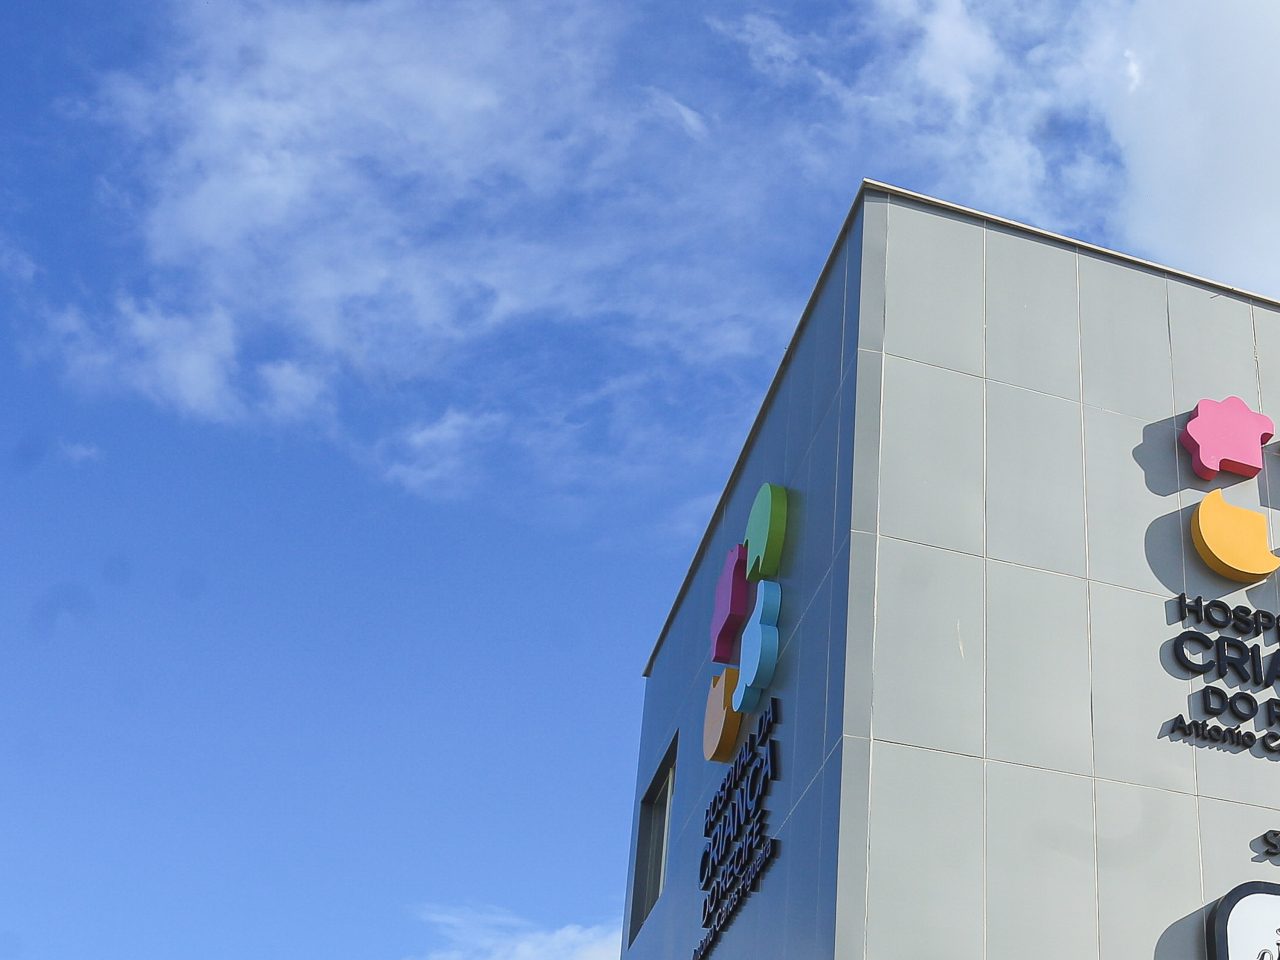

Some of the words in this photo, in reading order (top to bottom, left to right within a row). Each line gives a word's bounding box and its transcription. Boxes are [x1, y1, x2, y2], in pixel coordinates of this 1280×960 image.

[1203, 685, 1259, 722] DO
[1171, 713, 1257, 748] Antonio
[703, 733, 756, 838] HOSPITAL
